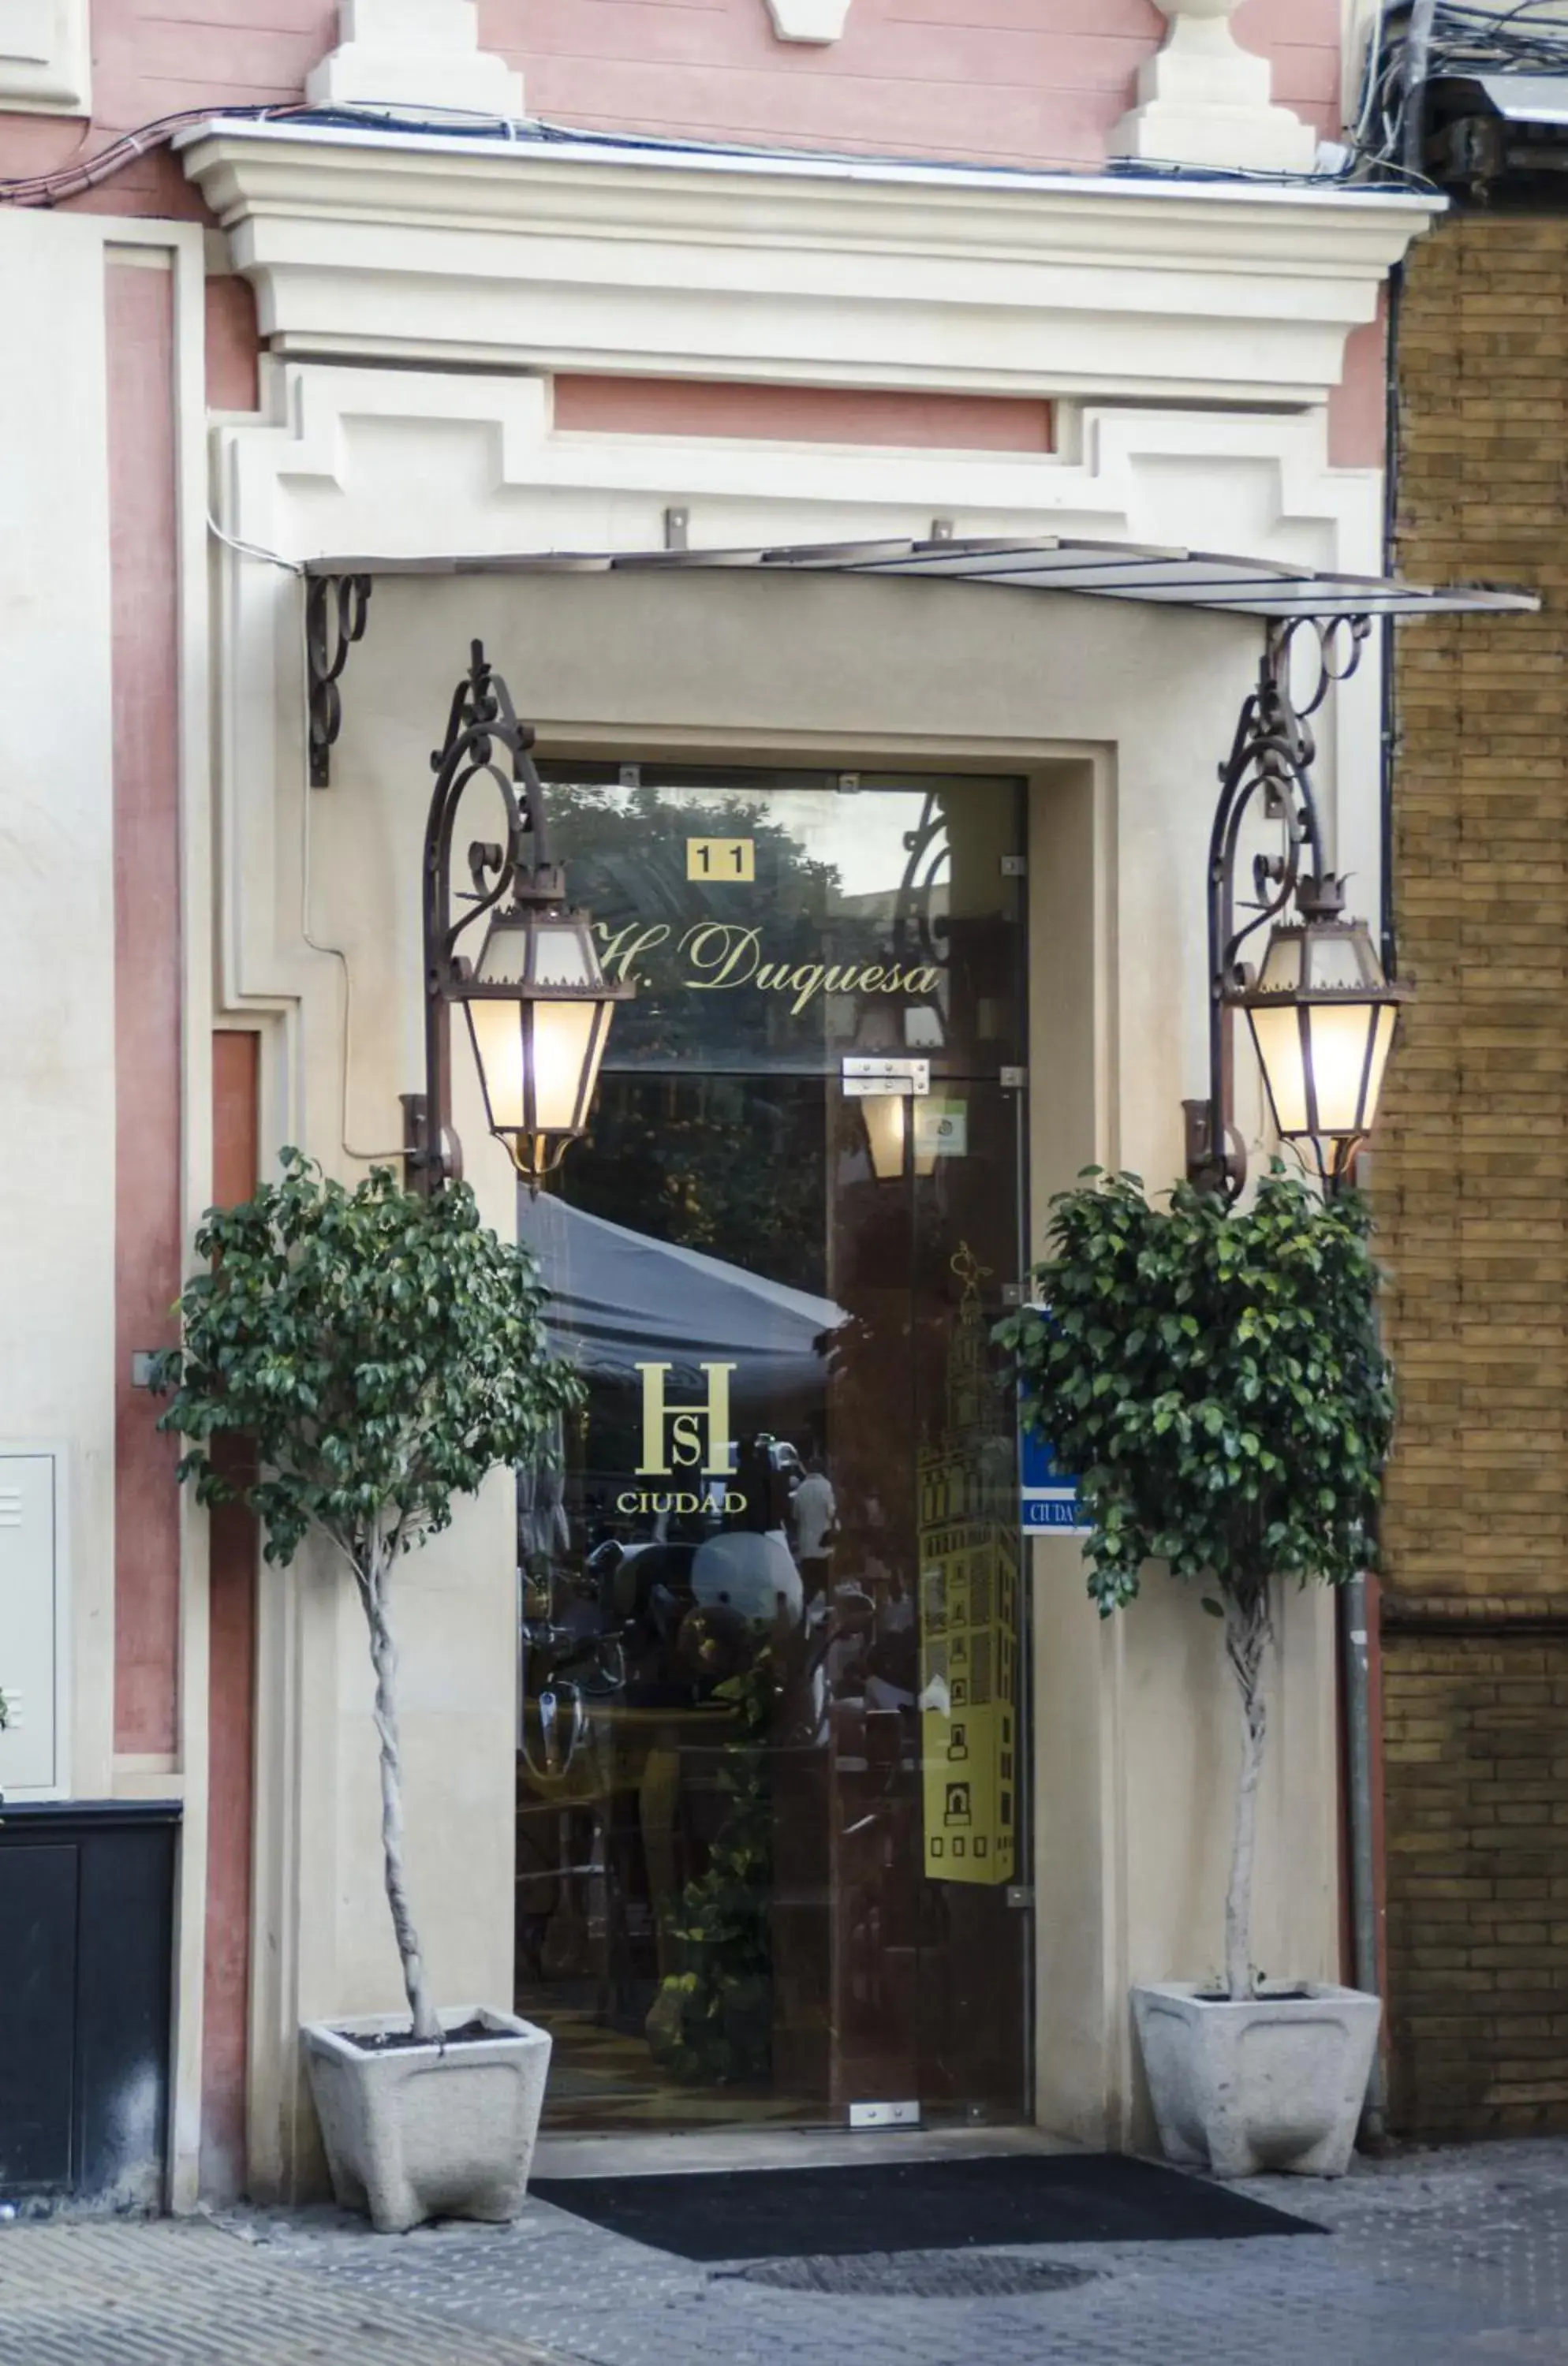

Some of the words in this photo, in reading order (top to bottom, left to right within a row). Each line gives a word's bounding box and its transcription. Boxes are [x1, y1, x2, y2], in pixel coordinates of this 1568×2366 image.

[696, 845, 744, 873] 11
[677, 921, 941, 1015] Duquesa
[616, 1491, 748, 1514] CIUDAD
[1030, 1502, 1082, 1522] CIUDA
